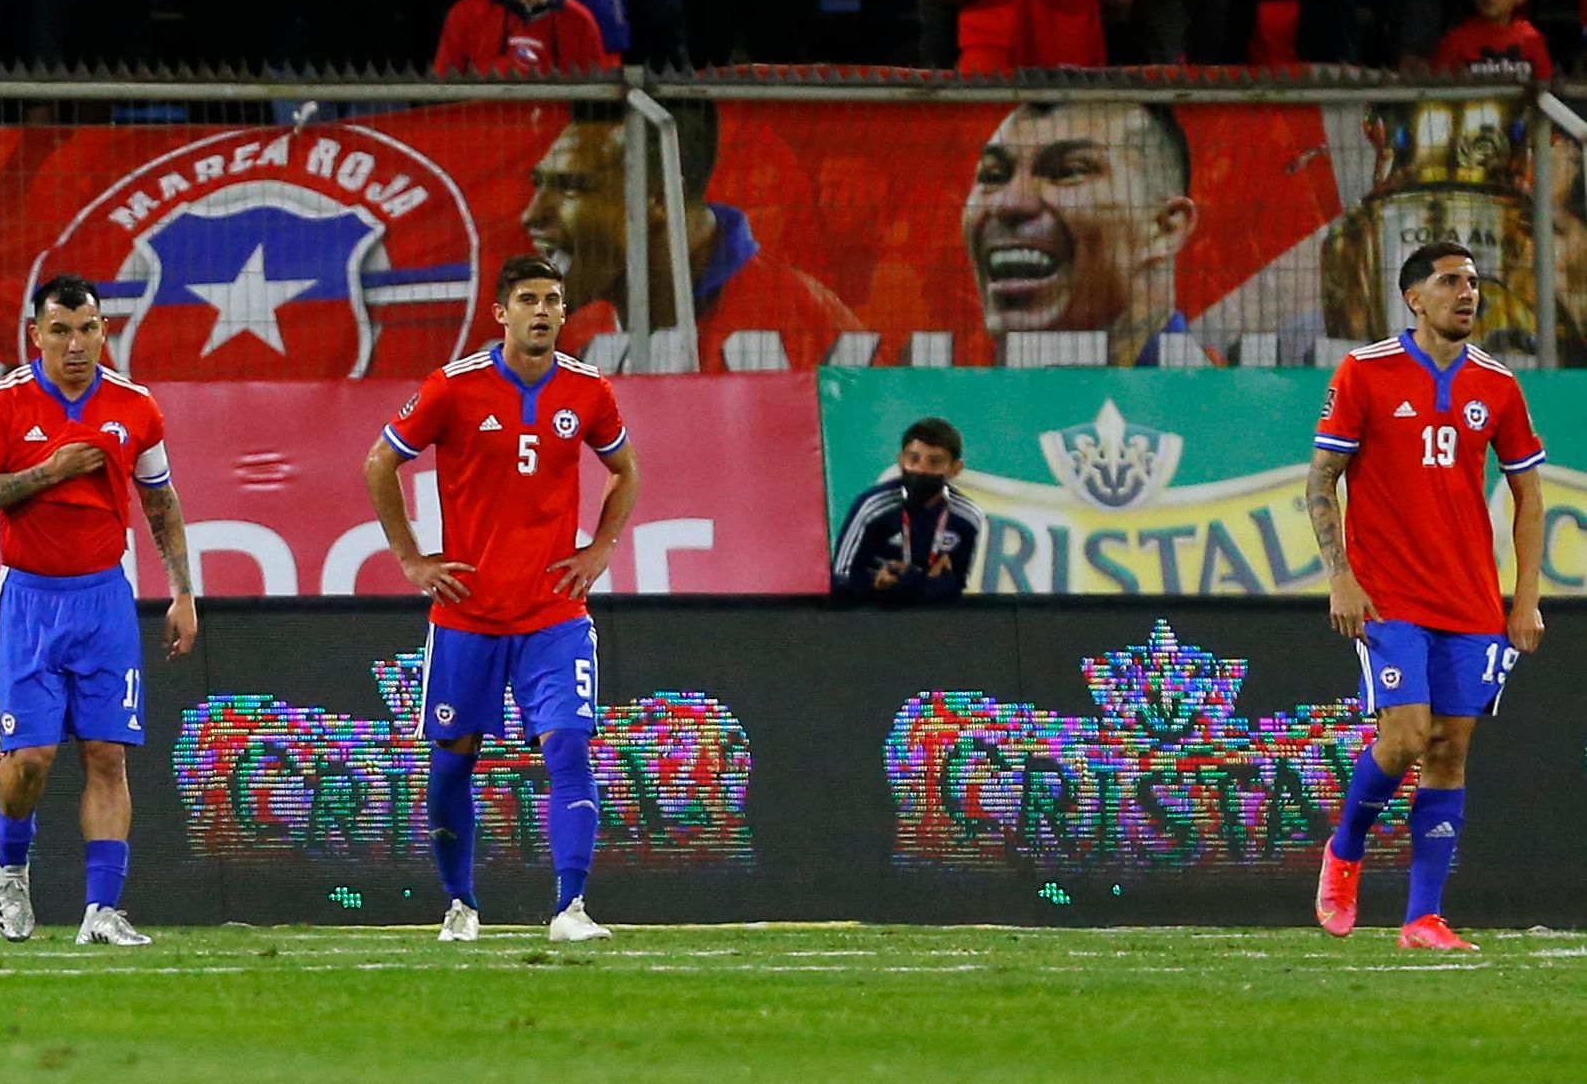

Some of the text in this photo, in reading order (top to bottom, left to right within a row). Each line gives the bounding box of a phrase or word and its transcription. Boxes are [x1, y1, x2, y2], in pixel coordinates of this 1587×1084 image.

[109, 134, 430, 231] MAREA ROJA
[518, 434, 539, 476] 5
[1421, 425, 1459, 468] 19
[979, 506, 1321, 595] RISTAL
[575, 659, 593, 697] 5
